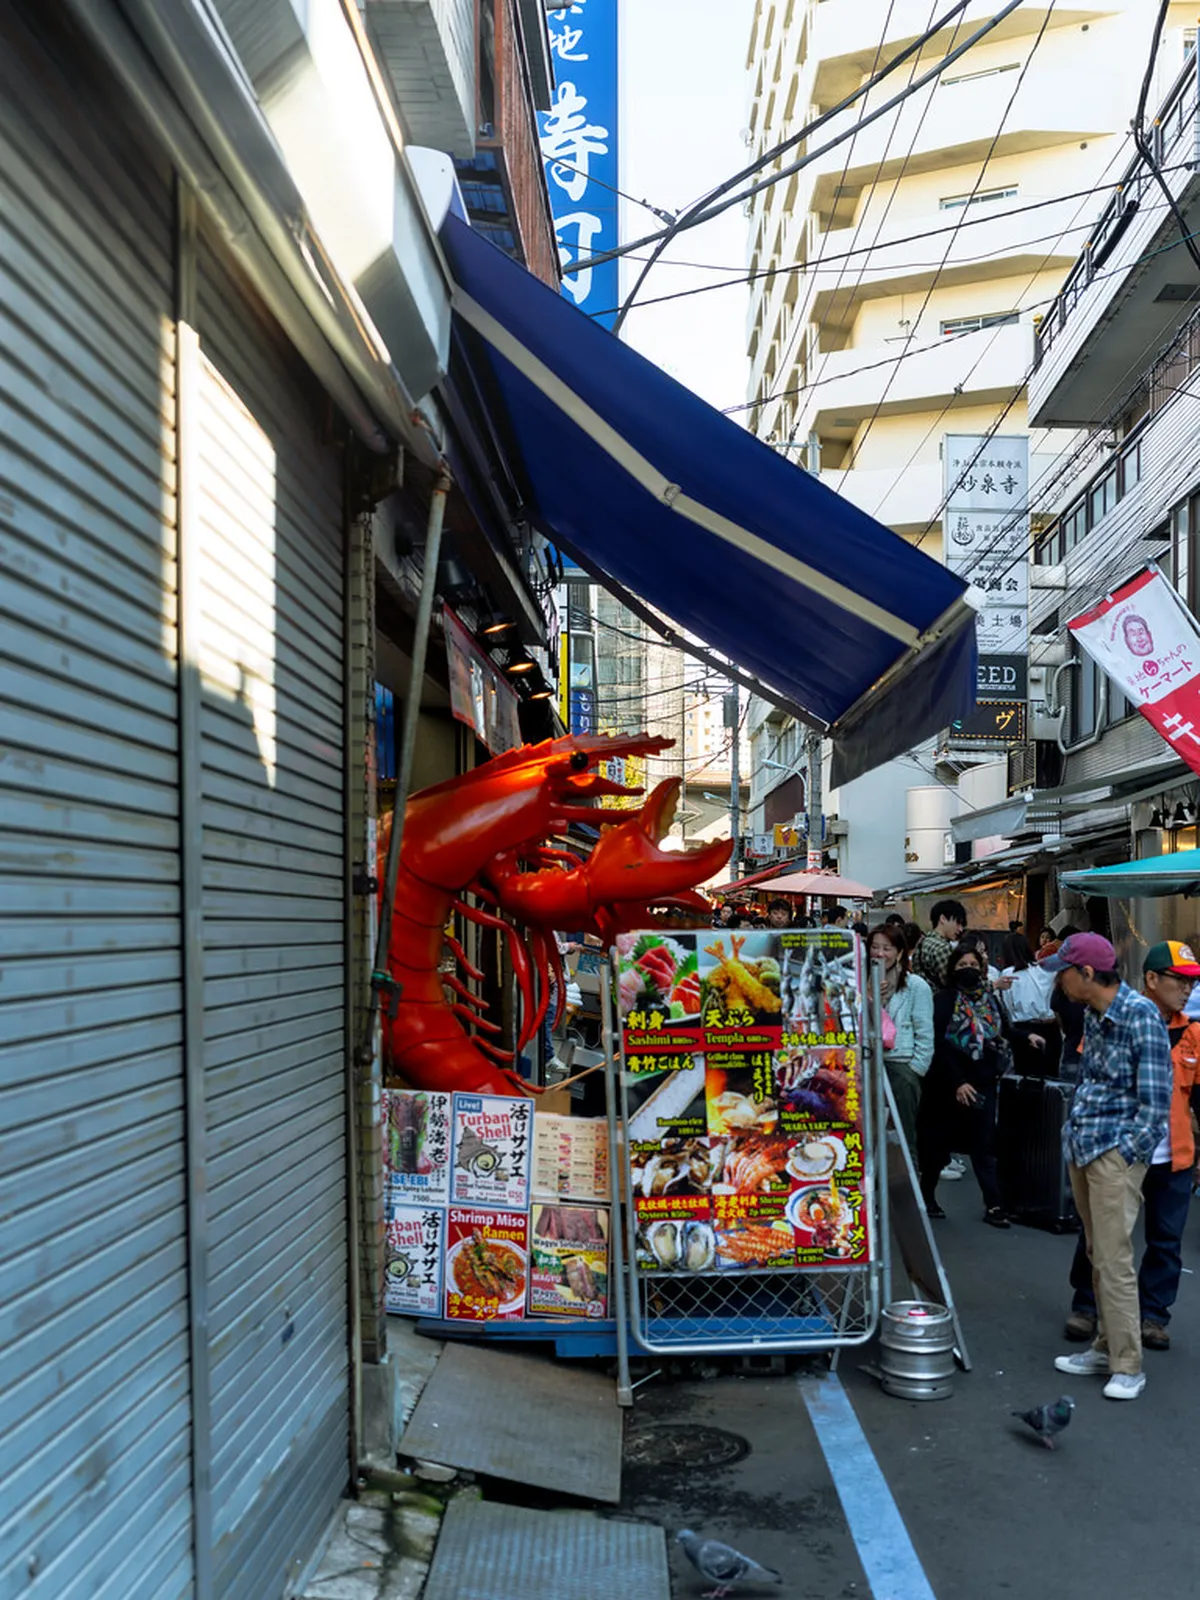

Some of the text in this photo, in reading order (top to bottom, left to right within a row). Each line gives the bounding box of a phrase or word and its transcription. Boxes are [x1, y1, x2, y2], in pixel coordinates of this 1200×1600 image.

[958, 473, 1019, 495] 妙泉寺
[1138, 659, 1194, 699] ケーマート
[627, 1010, 664, 1031] 刺身
[627, 1033, 671, 1046] Sashimi
[457, 1111, 511, 1127] Turban
[428, 1094, 448, 1164] 伊勢海老
[476, 1124, 512, 1139] Shell
[509, 1103, 530, 1178] 活けサザエ
[386, 1218, 422, 1233] rban
[450, 1210, 526, 1228] Shrimp Miso
[847, 1190, 867, 1260] ラーメン
[388, 1231, 424, 1246] Shell
[482, 1225, 525, 1241] Ramen
[422, 1211, 442, 1285] 活けサザエ
[797, 1246, 825, 1255] Ramen
